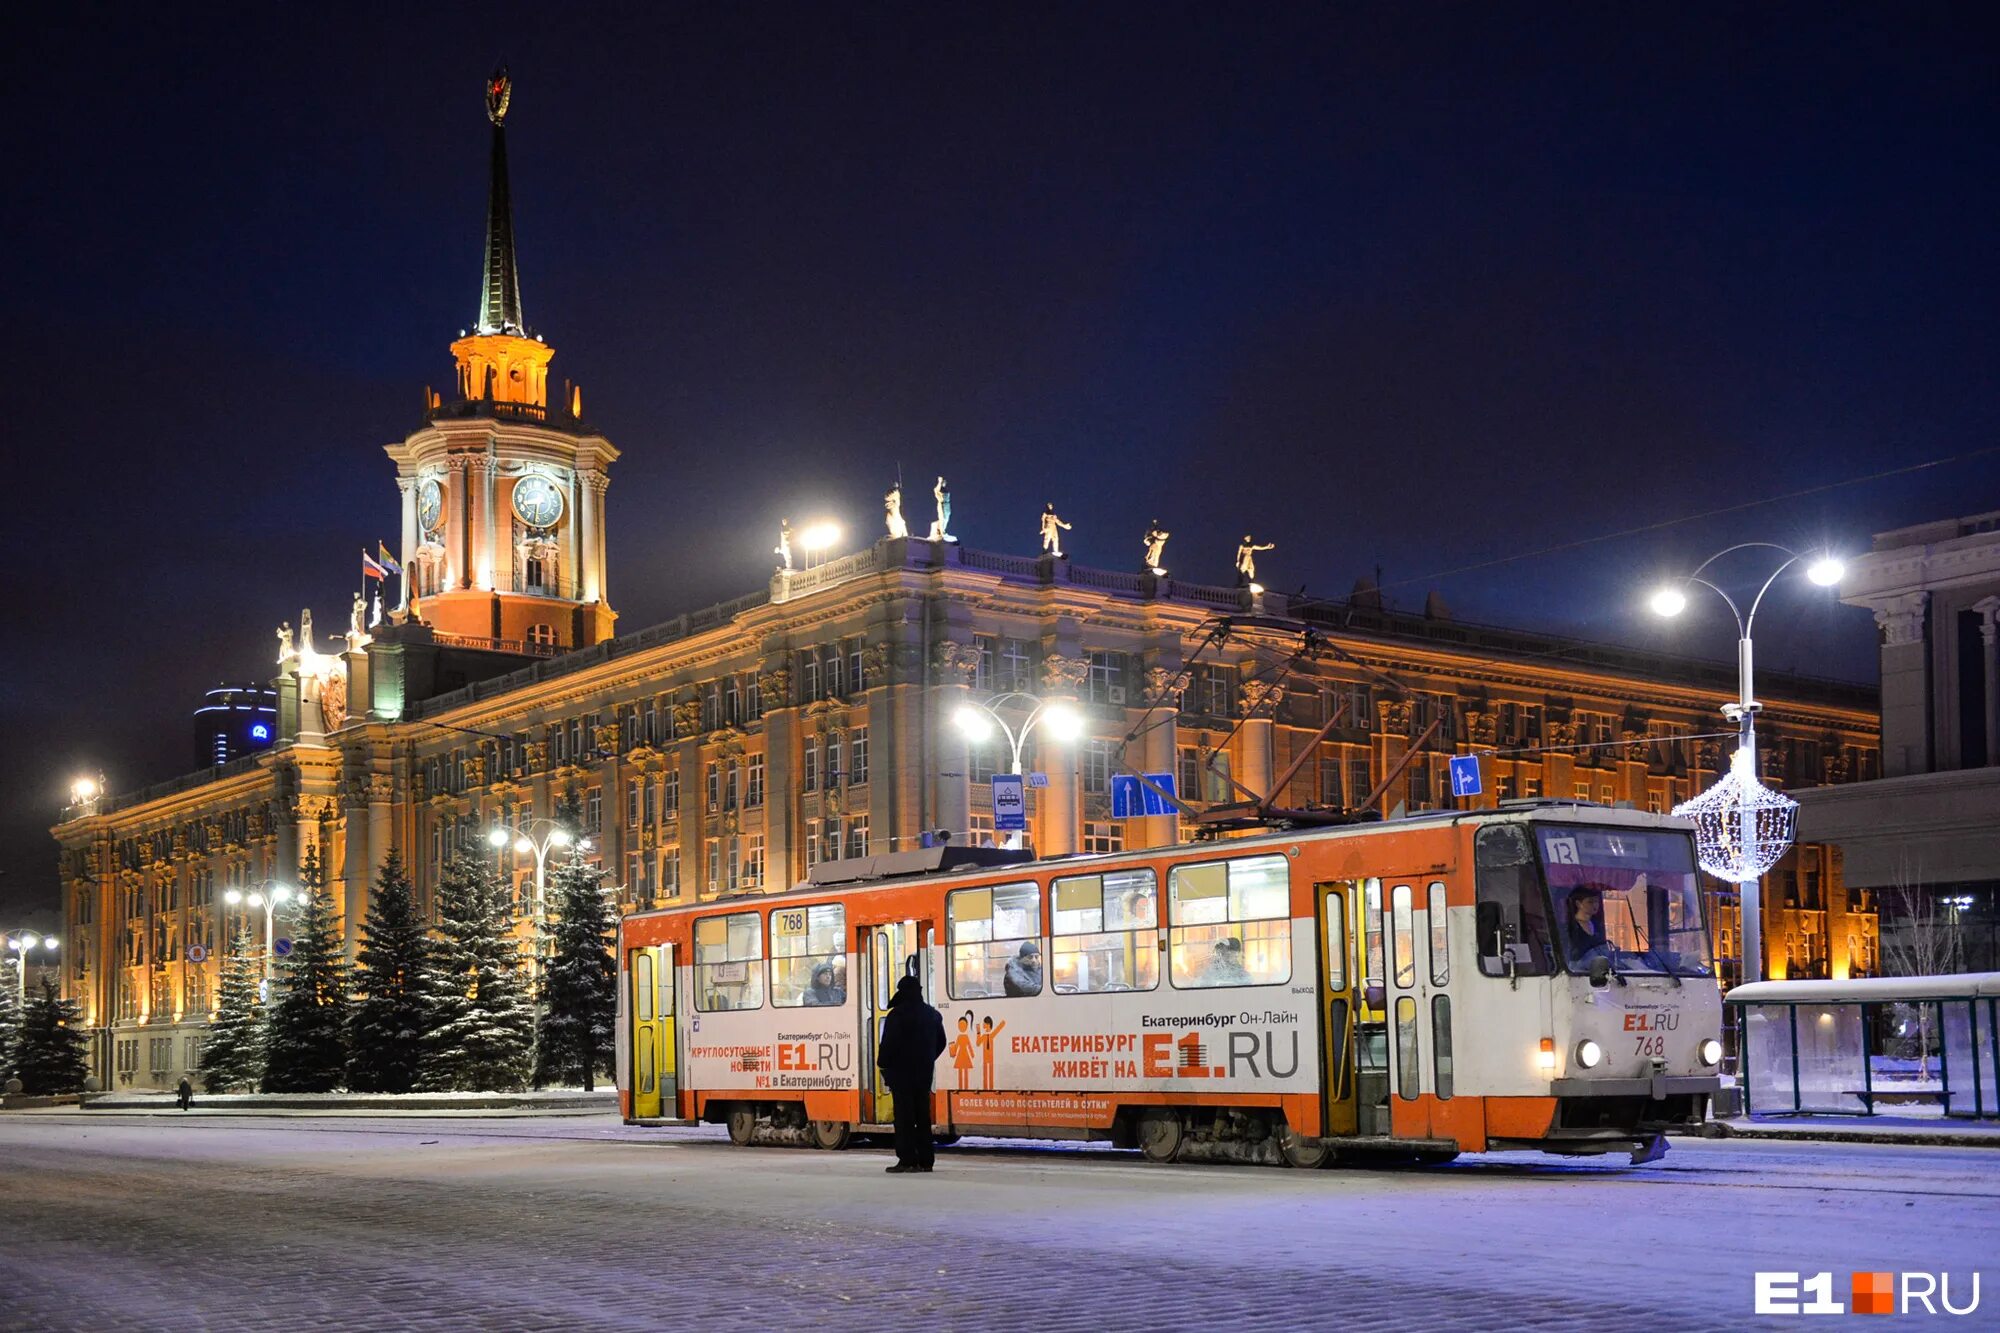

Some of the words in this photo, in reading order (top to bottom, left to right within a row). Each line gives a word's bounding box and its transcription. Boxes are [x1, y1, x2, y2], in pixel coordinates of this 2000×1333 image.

[782, 914, 802, 930] 768
[1142, 1013, 1237, 1029] Екатеринбург
[1240, 1010, 1298, 1025] Он-Лайн
[1624, 1014, 1679, 1031] E1.RU
[777, 1032, 822, 1042] Екатеринбург
[824, 1031, 850, 1041] Он-Лайн
[1011, 1034, 1137, 1053] ЕКАТЕРИНБУРГ
[691, 1045, 771, 1058] КРУГЛОСУТОЧНЫЕ
[1142, 1030, 1299, 1079] E1.RU
[1634, 1036, 1664, 1056] 768
[778, 1043, 851, 1071] E1.RU
[730, 1061, 771, 1073] НОВОСТИ
[1052, 1056, 1108, 1078] ЖИВЁТ
[1114, 1060, 1137, 1078] НА
[755, 1075, 771, 1088] №1
[772, 1078, 779, 1087] в
[960, 1098, 983, 1107] БОЛЕЕ
[1016, 1098, 1071, 1109] ПОСЕТИТЕЛЕЙ
[1073, 1100, 1079, 1109] В
